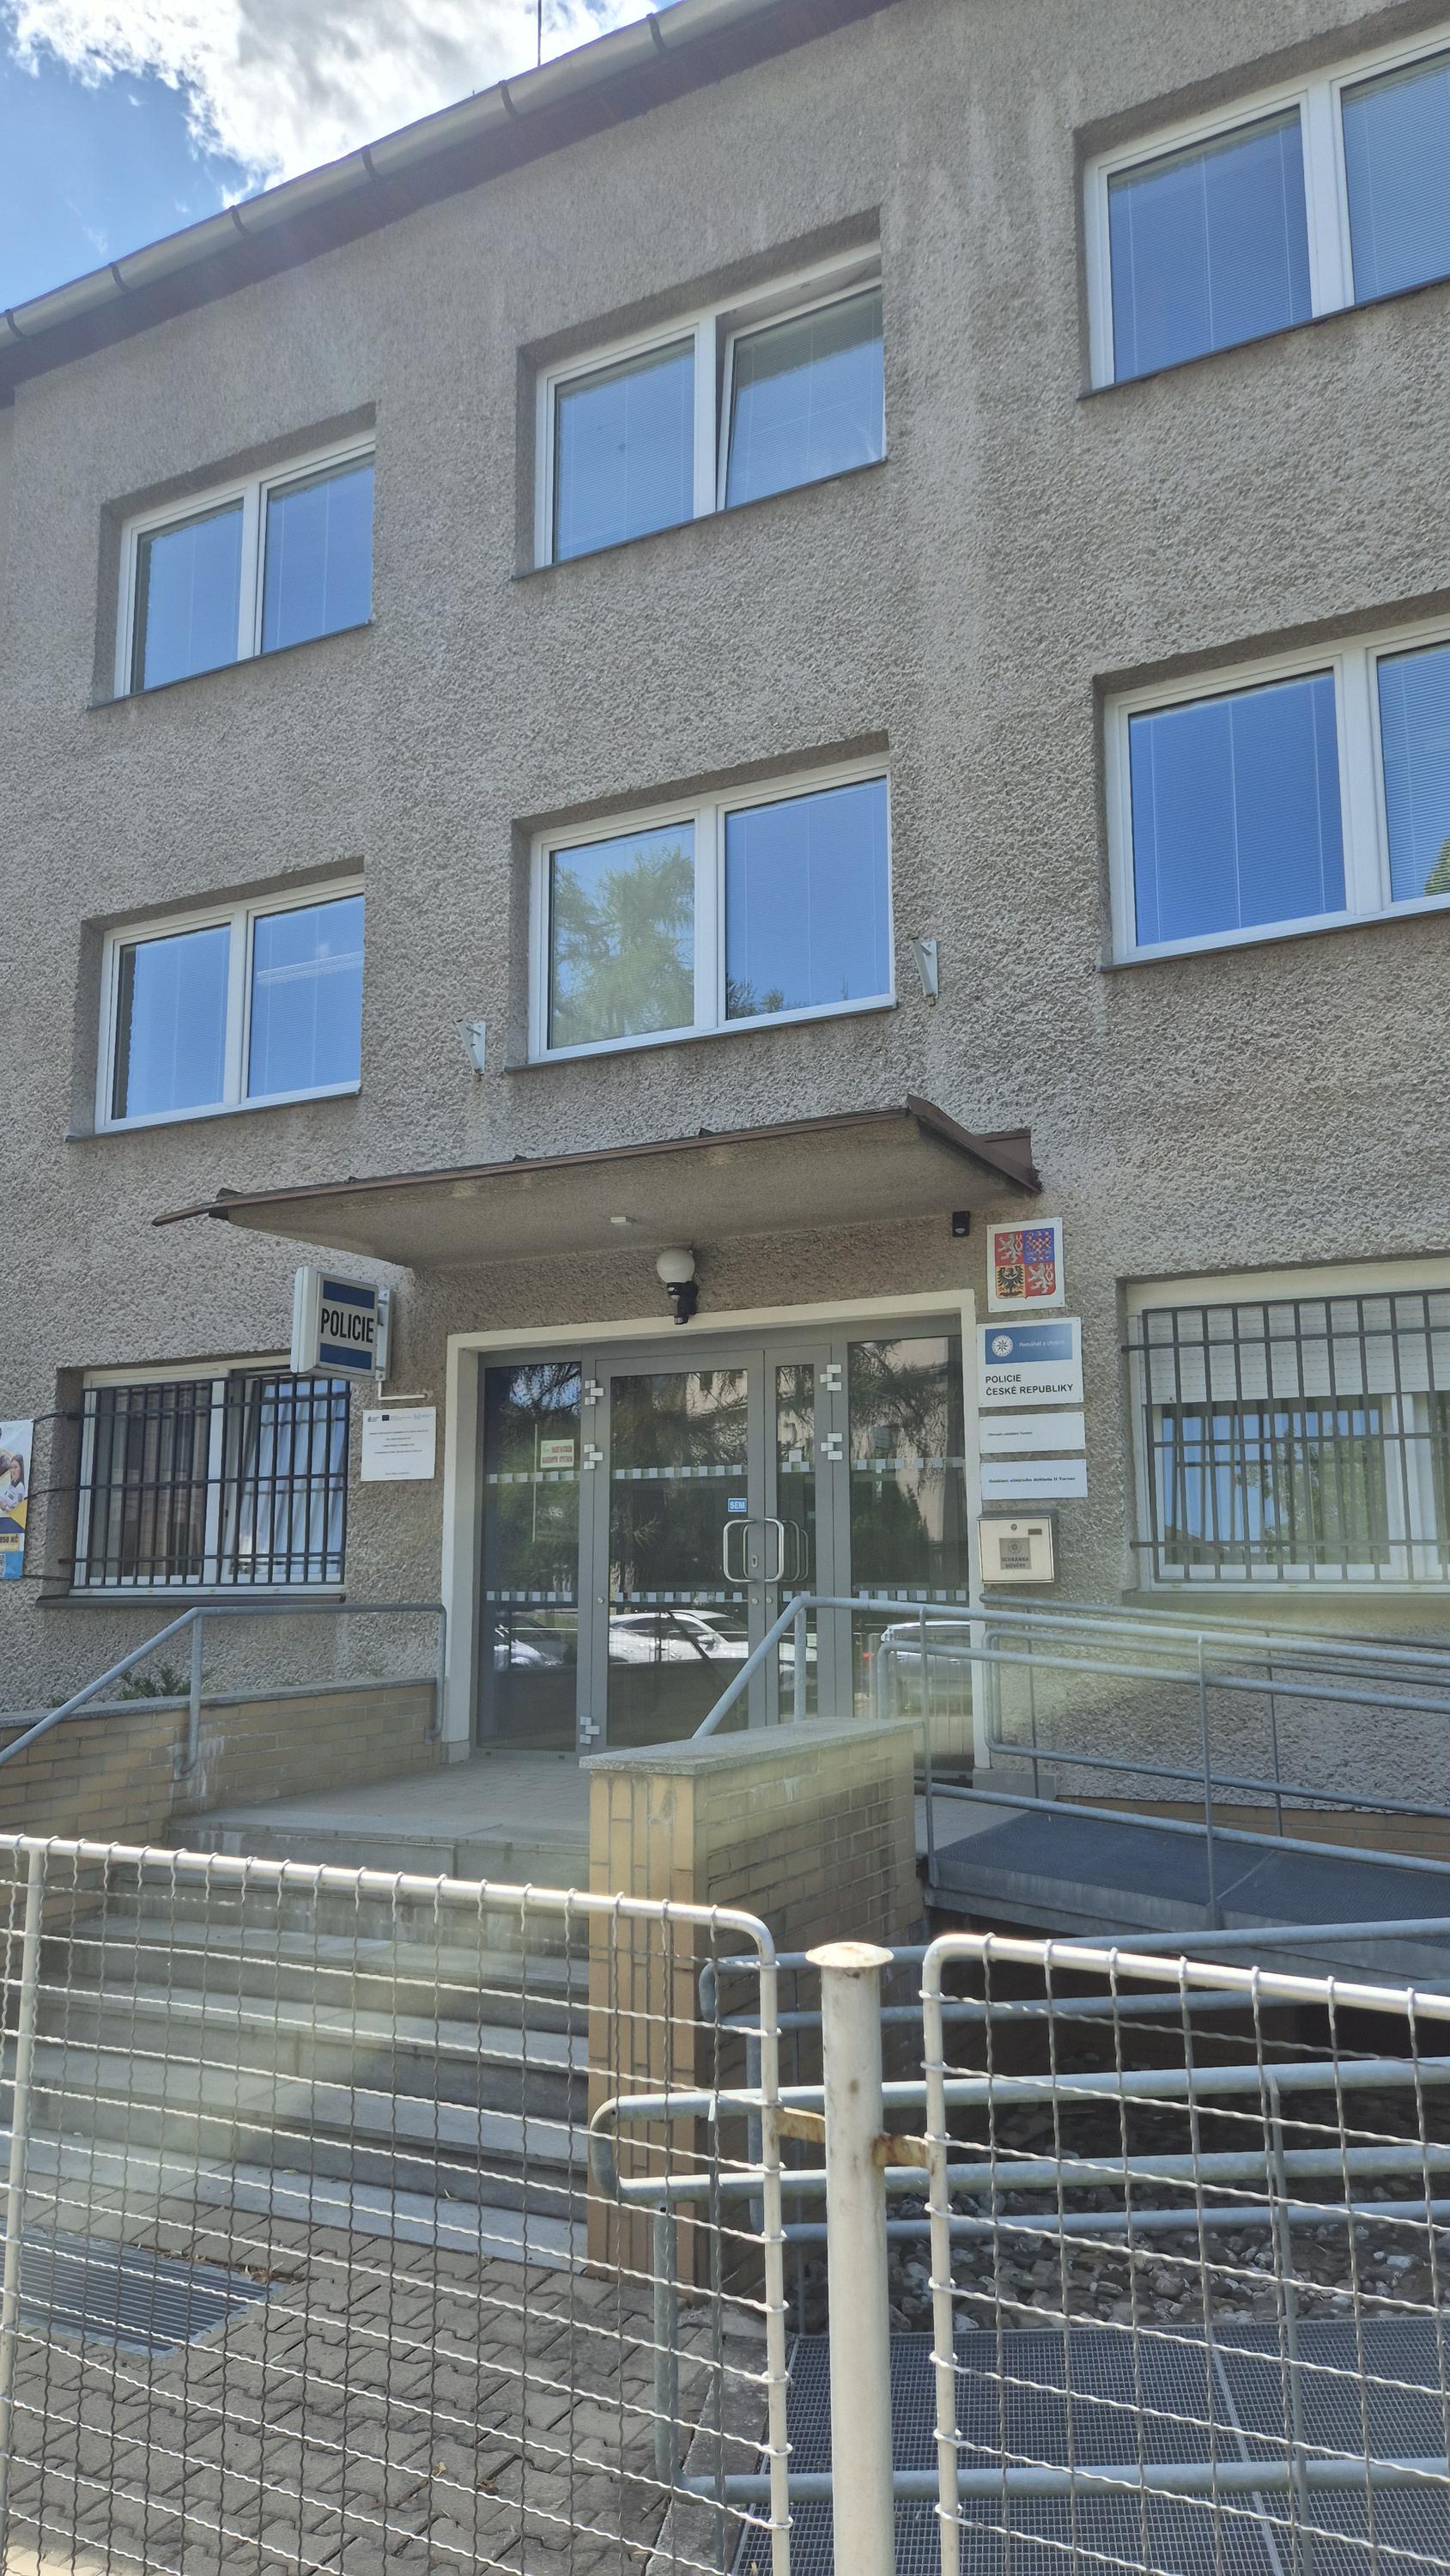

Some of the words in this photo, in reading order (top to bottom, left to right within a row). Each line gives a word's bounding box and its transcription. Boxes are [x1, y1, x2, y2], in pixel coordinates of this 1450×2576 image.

[321, 1308, 374, 1343] POLICIE
[986, 1375, 1022, 1383] POLICIE
[986, 1385, 1017, 1396] ČESKÉ
[1019, 1384, 1073, 1394] REPUBLIKY
[730, 1501, 745, 1510] SEM
